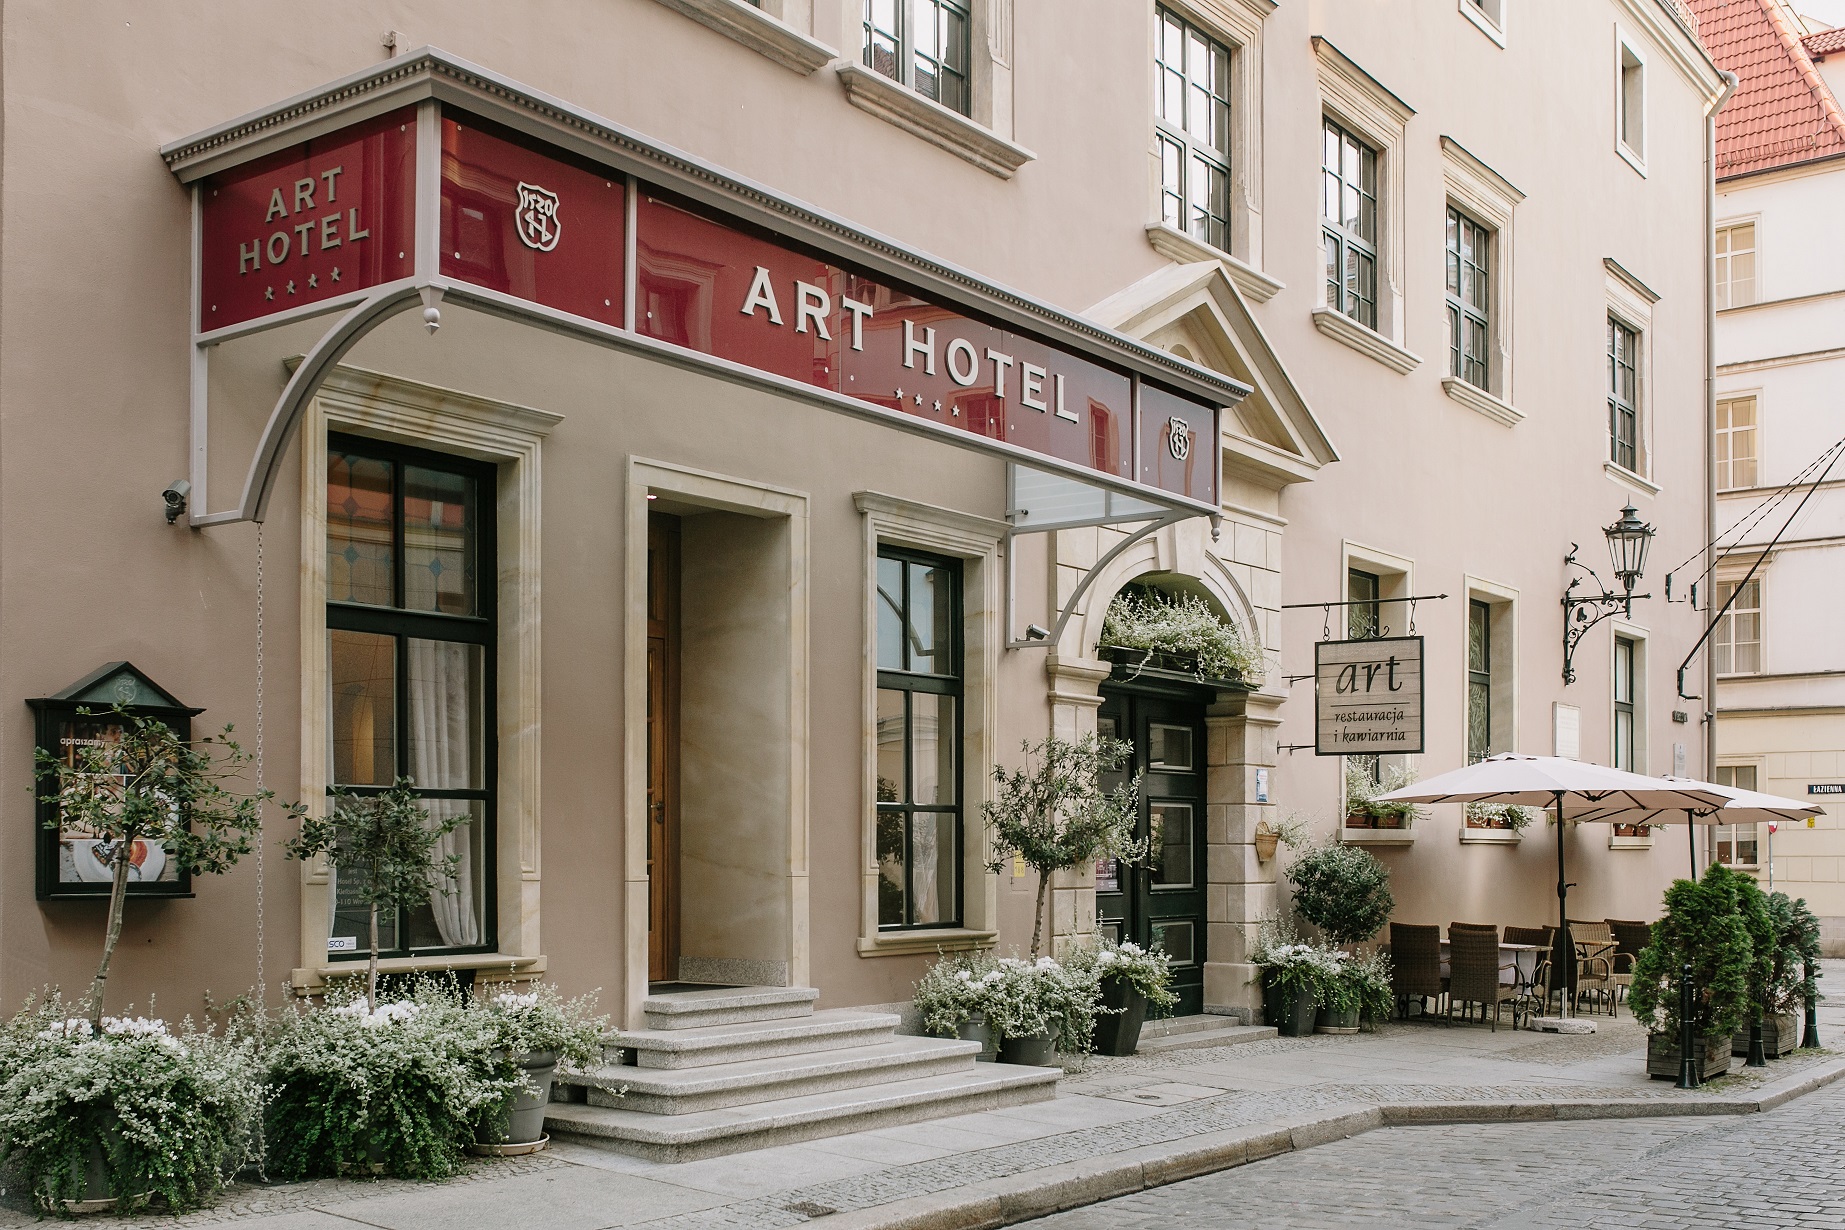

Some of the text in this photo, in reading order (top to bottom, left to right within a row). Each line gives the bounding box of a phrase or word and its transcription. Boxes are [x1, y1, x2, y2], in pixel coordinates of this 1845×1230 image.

[265, 165, 342, 223] ART
[239, 207, 370, 275] HOTEL
[739, 265, 1080, 424] ART HOTEL
[1335, 655, 1402, 694] art
[1333, 726, 1405, 743] i kawiarnia
[1335, 707, 1404, 725] restauracja
[60, 737, 104, 748] apraszamy
